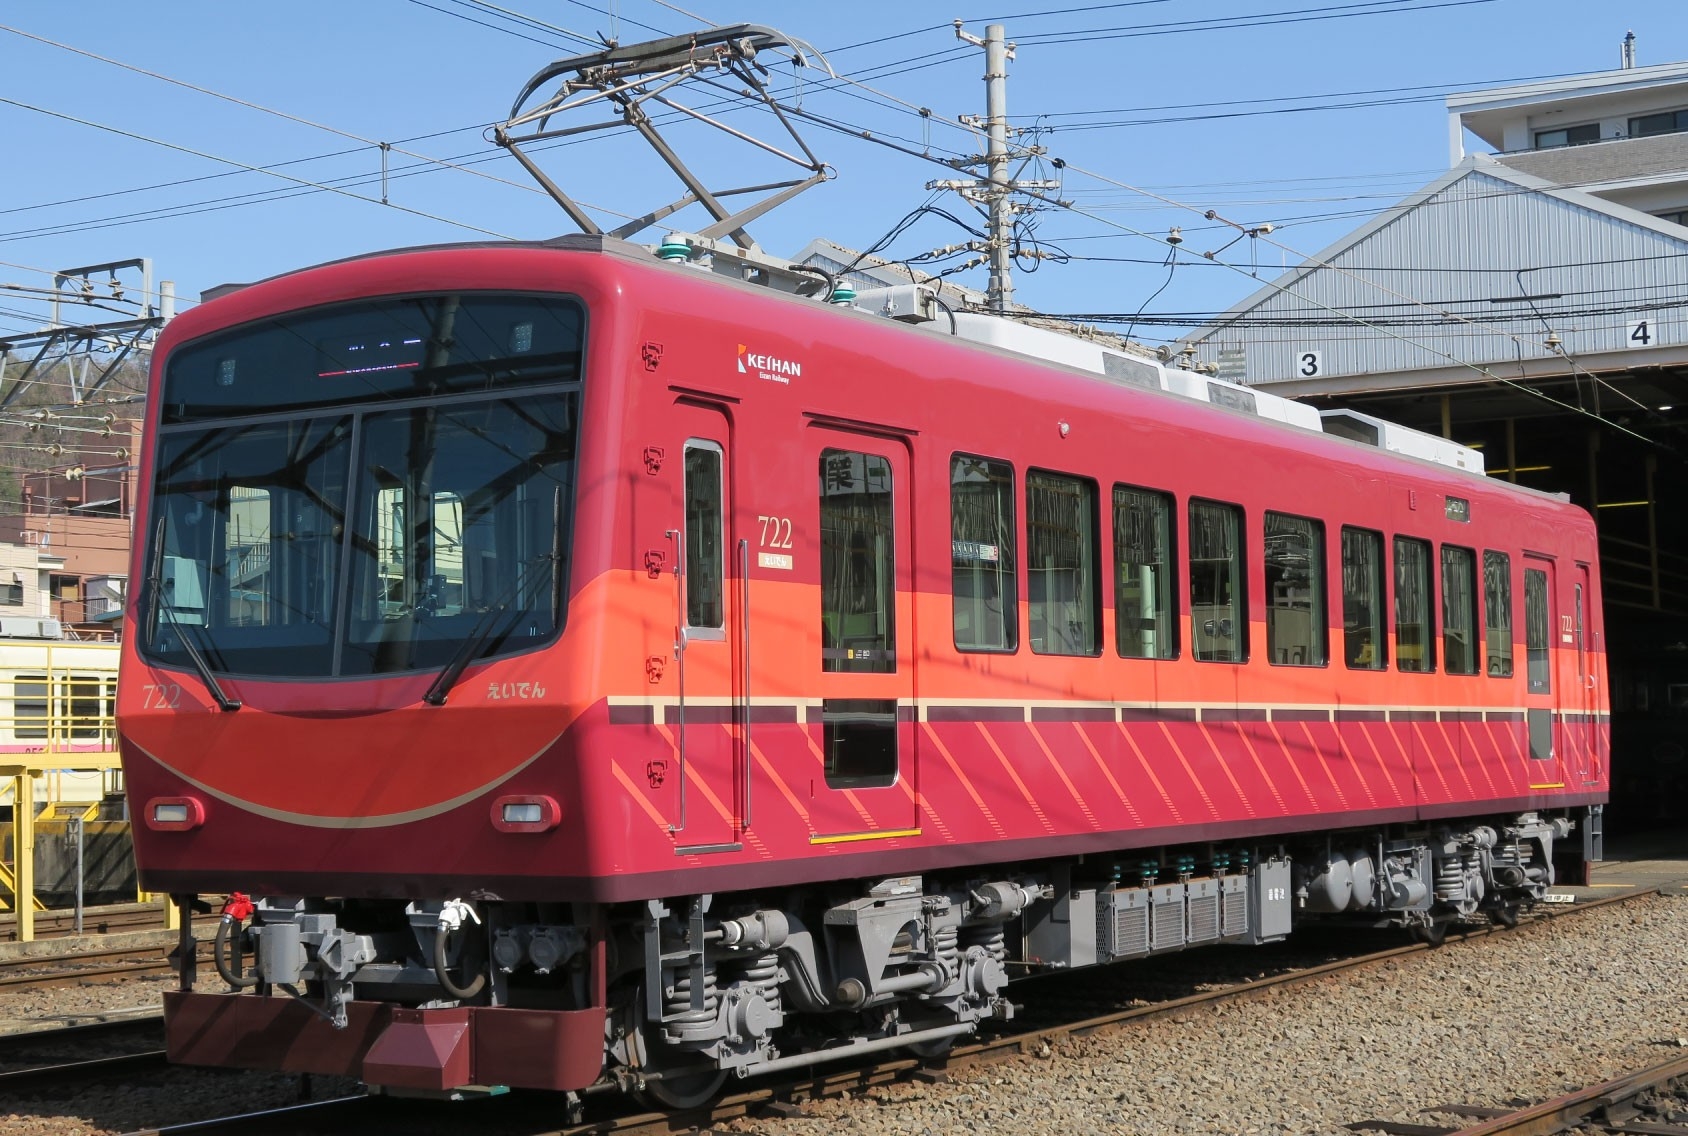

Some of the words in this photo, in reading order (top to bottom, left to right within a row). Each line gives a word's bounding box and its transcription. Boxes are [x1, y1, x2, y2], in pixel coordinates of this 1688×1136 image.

[1631, 321, 1651, 345] 4
[747, 353, 801, 377] KEIHAN
[1301, 353, 1318, 376] 3
[758, 515, 792, 549] 722
[1561, 615, 1573, 632] 722
[143, 684, 181, 710] 722
[487, 681, 546, 700] えいでん
